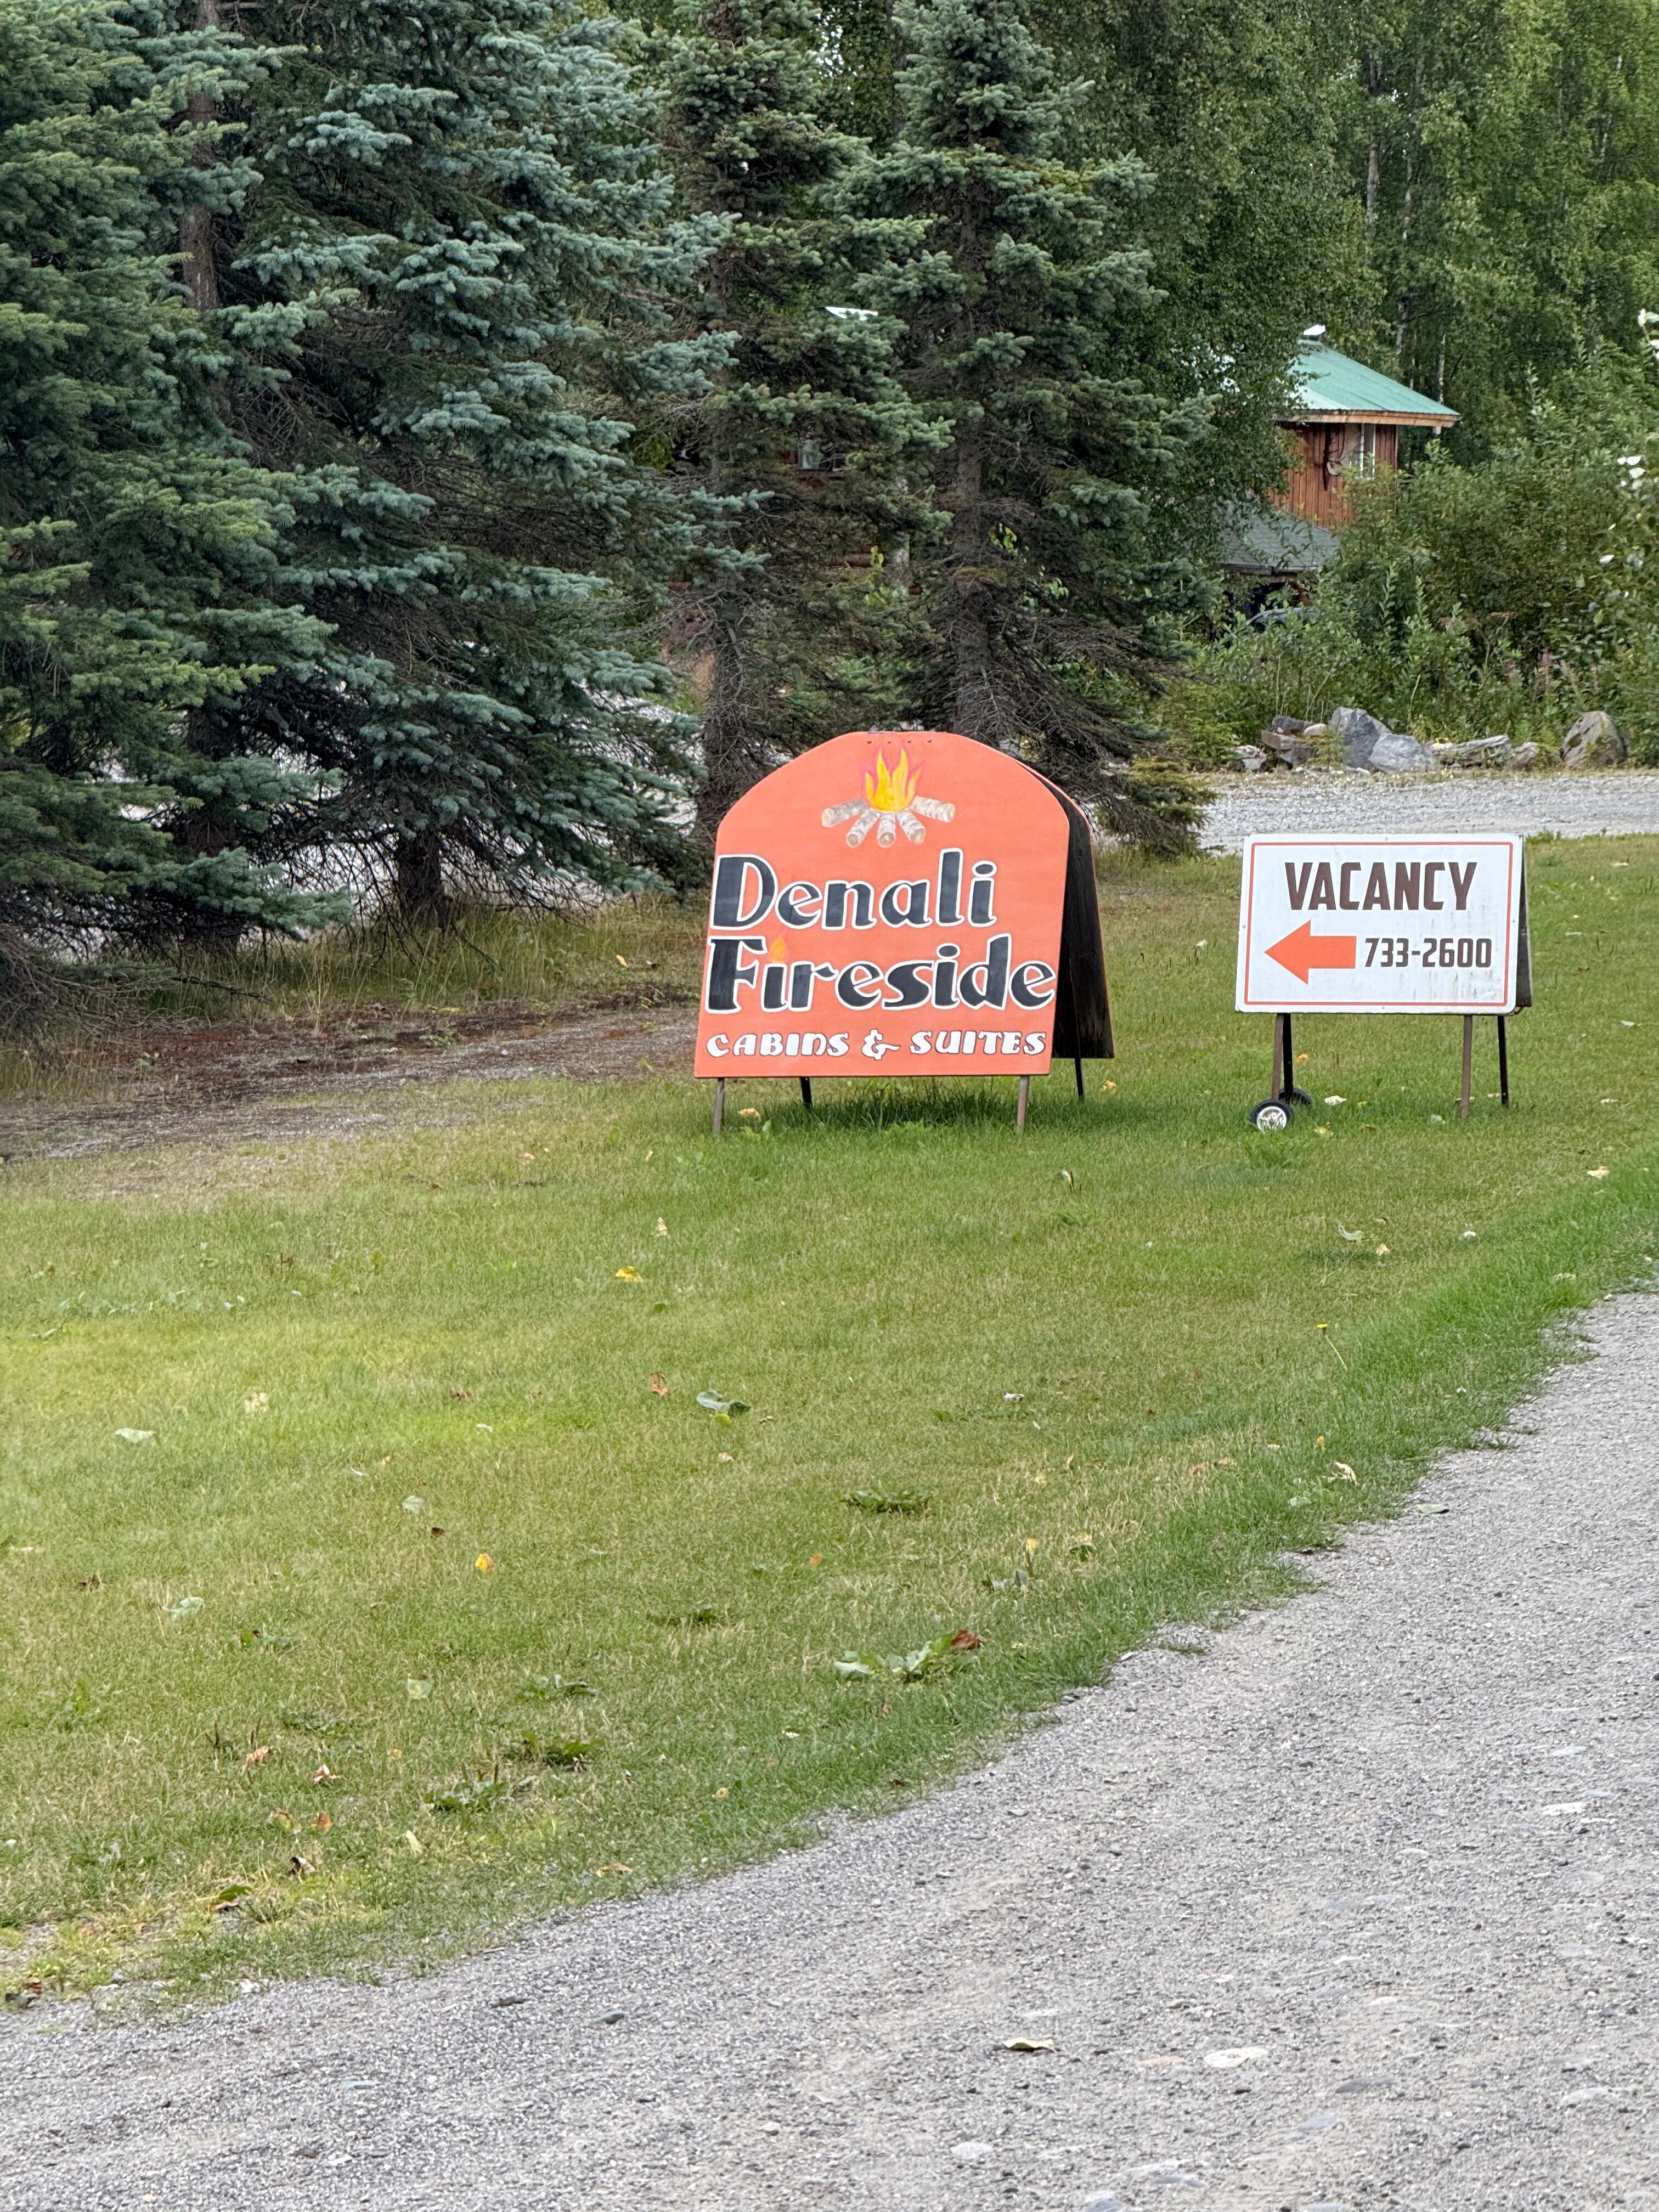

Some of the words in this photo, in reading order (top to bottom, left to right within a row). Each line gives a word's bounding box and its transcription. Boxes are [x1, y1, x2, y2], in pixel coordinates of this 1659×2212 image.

[708, 848, 997, 930] Denali
[1284, 862, 1477, 911] VACANCY
[706, 934, 1057, 1012] Fireside
[1364, 938, 1492, 968] 733-2600
[707, 1032, 849, 1058] CABINS
[861, 1029, 900, 1060] &
[910, 1030, 1047, 1056] SUITES
